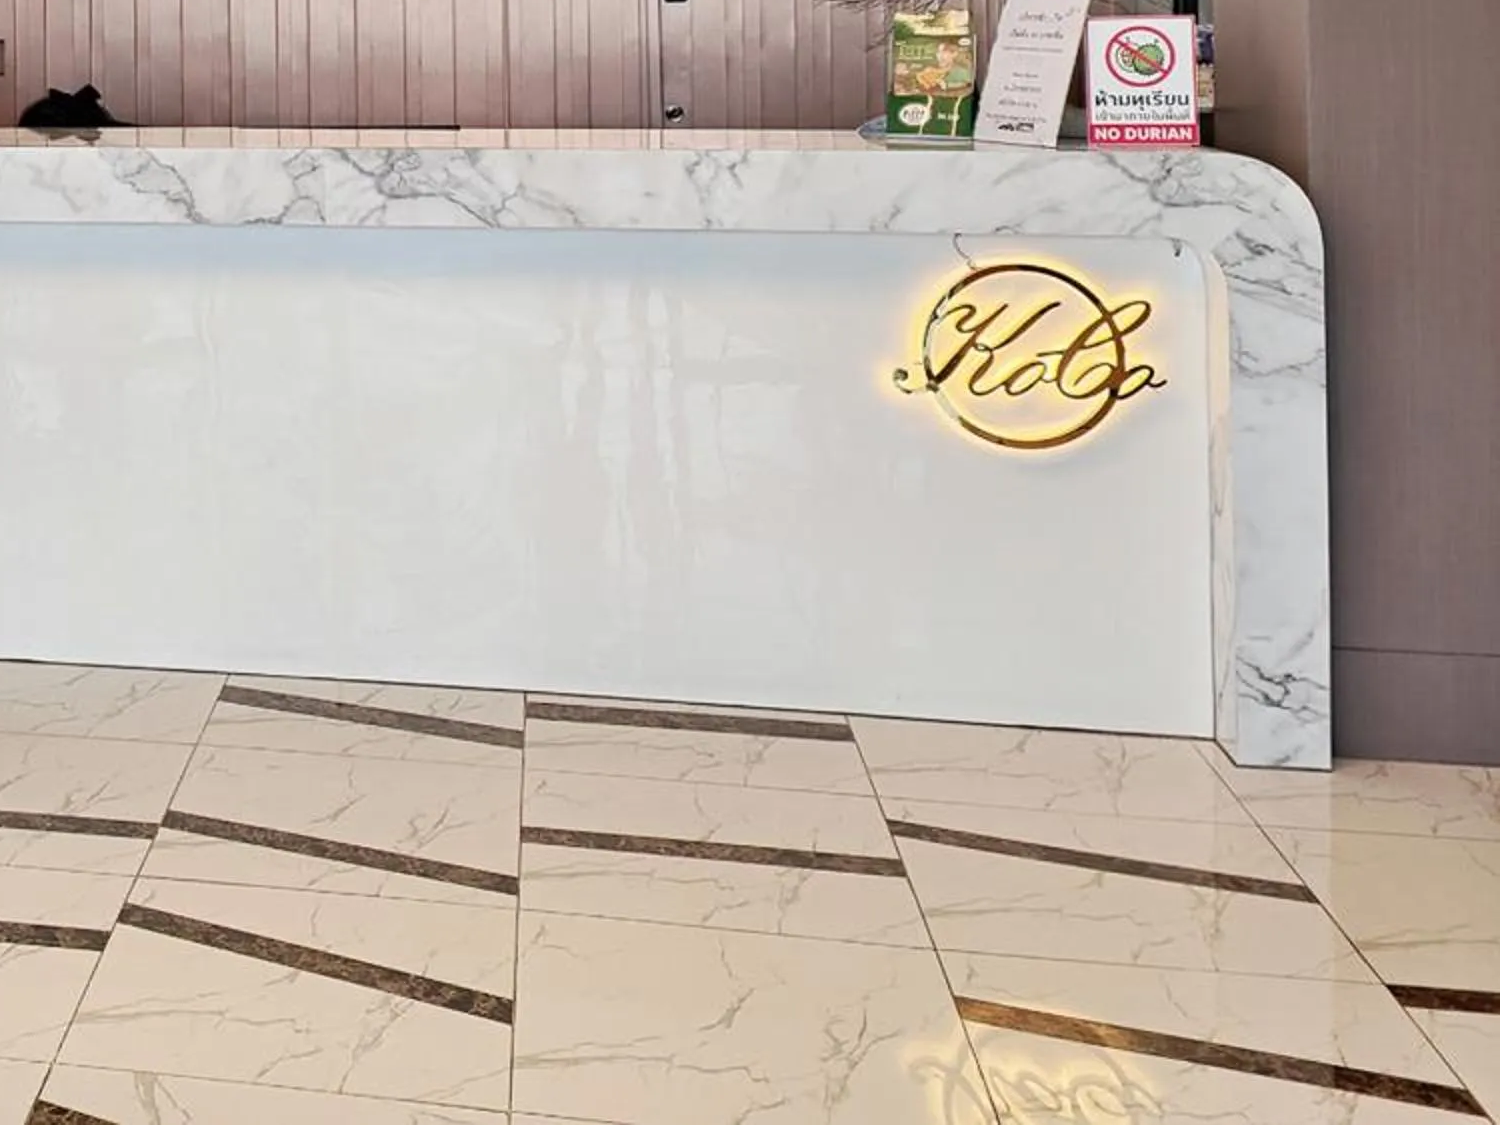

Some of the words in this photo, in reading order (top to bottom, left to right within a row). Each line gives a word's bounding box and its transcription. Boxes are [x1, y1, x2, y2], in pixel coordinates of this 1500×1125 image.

[1094, 90, 1190, 112] ห้ามทุเรียน
[1094, 126, 1121, 141] NO
[1124, 126, 1193, 141] DURIAN
